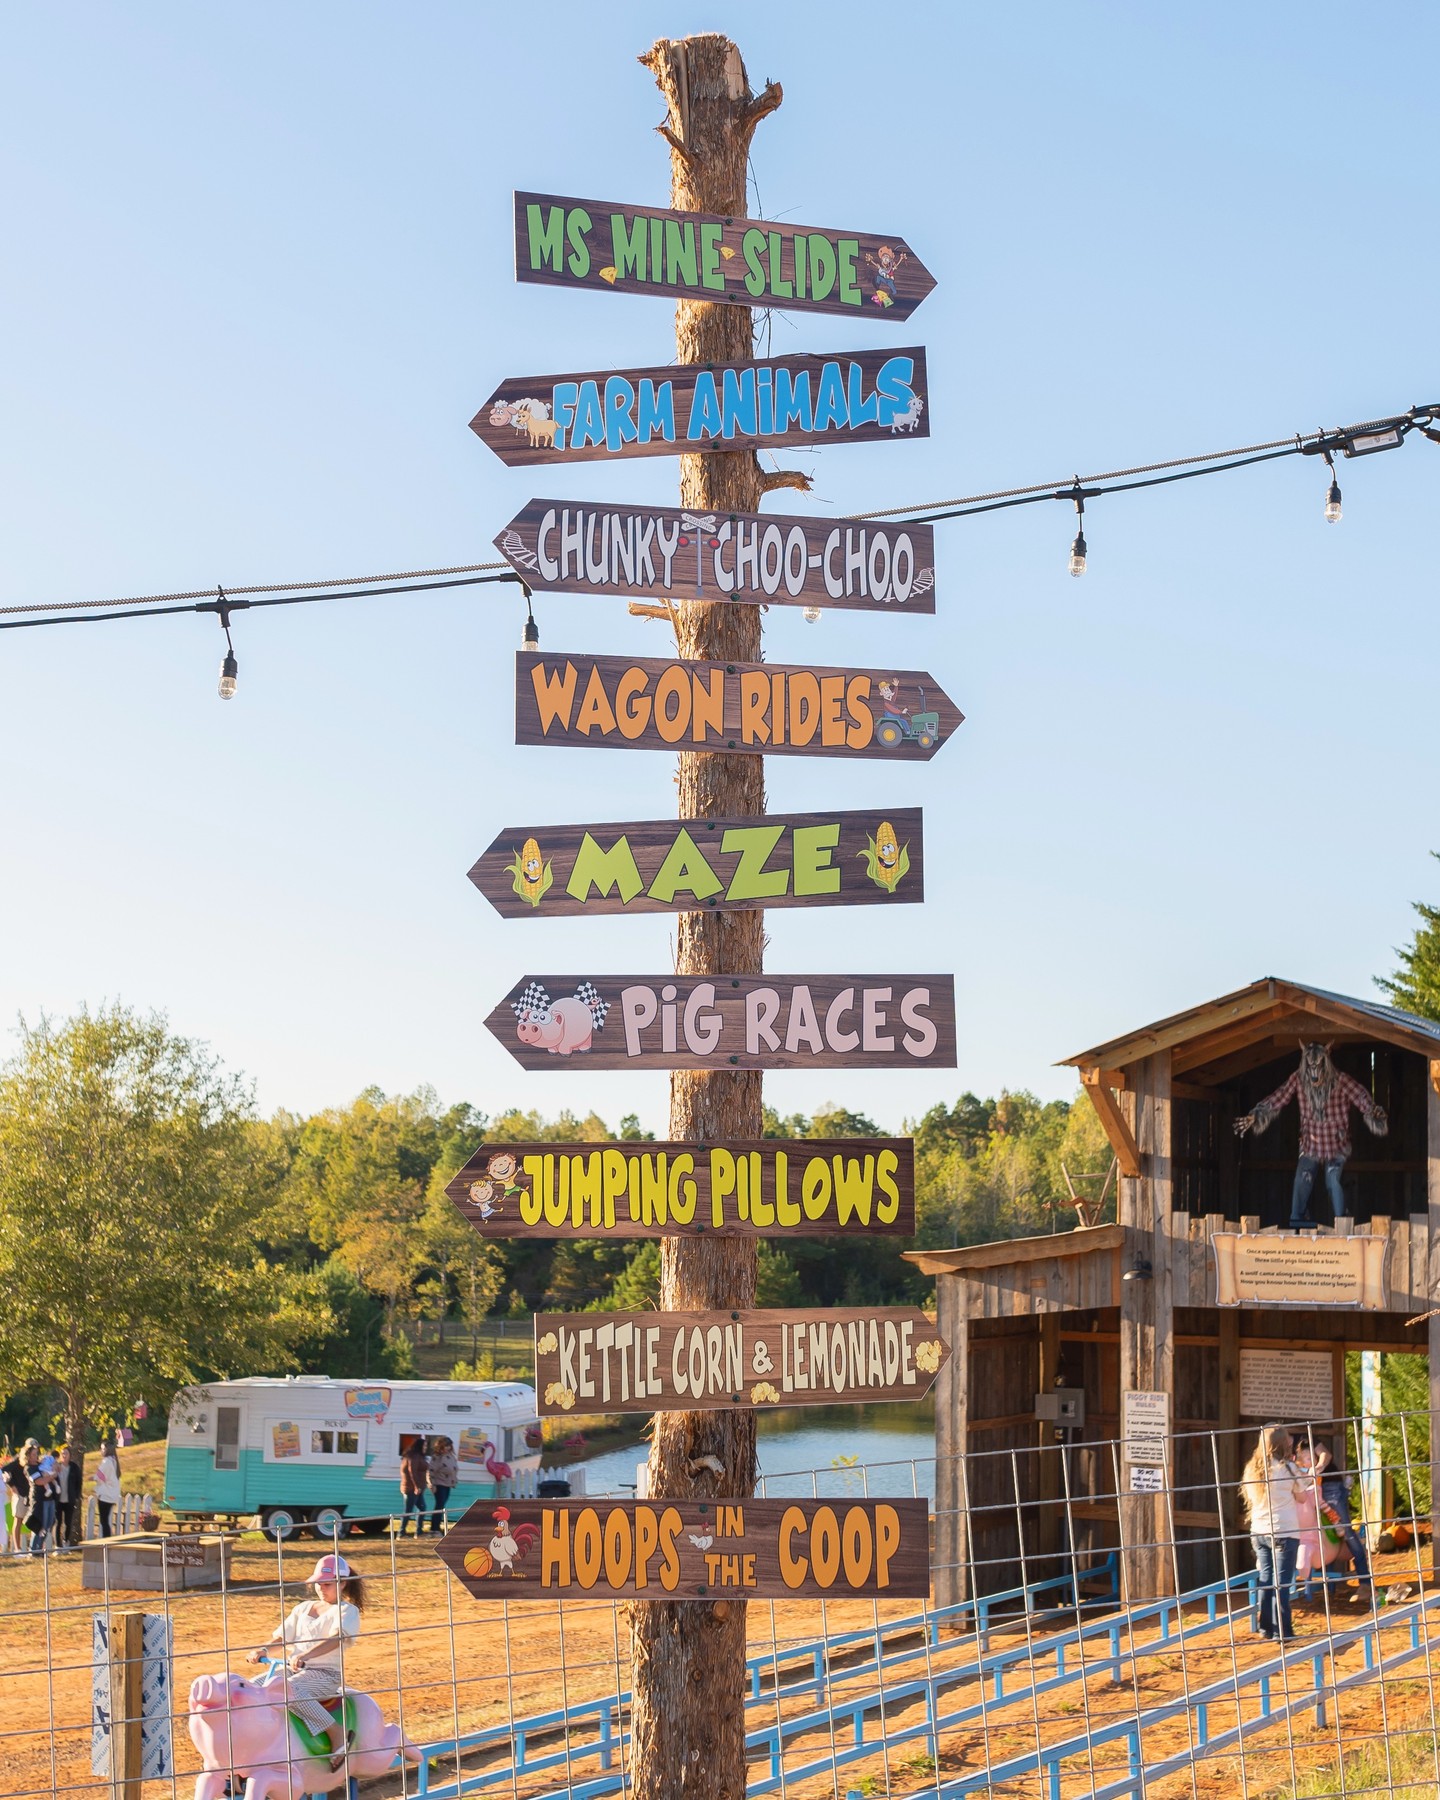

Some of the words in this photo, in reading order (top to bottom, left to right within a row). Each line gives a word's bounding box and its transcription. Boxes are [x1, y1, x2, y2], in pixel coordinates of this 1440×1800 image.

[526, 203, 593, 278] MS
[610, 213, 727, 291] MINE
[742, 227, 862, 306] SLIDE
[553, 376, 676, 451] FARM
[536, 508, 678, 588] CHUNKY
[712, 520, 914, 602] CHOO-CHOO
[530, 660, 724, 744] WAGON
[740, 670, 874, 750] RIDES
[565, 823, 841, 905] MAZE
[744, 985, 938, 1058] RACES
[518, 1148, 698, 1229] JUMPING
[710, 1147, 900, 1229] PILLOWS
[557, 1320, 662, 1403] KETTLE
[671, 1322, 744, 1400] CORN
[752, 1339, 775, 1374] &
[780, 1318, 917, 1393] LEMONADE
[540, 1506, 685, 1592] HOOPS
[715, 1504, 745, 1538] IN
[704, 1553, 758, 1588] THE
[778, 1503, 902, 1590] COOP
